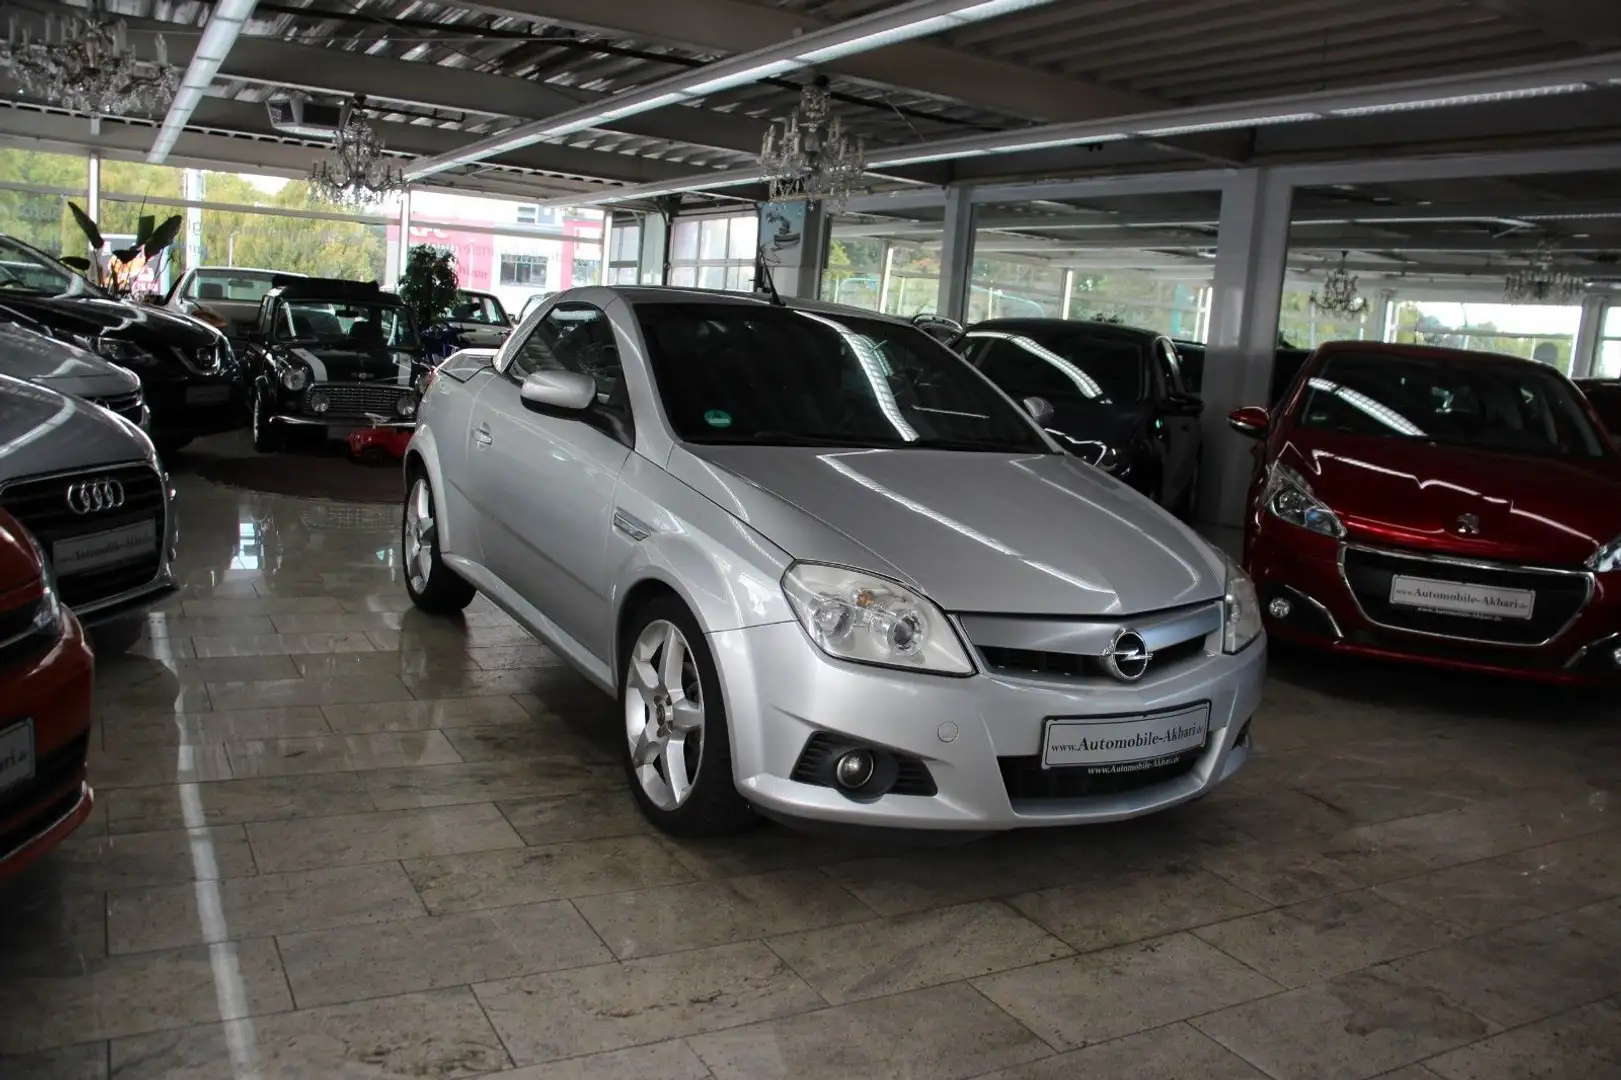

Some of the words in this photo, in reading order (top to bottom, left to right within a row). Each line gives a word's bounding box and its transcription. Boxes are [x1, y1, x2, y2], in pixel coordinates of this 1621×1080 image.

[1396, 588, 1528, 609] www.Automobile-Akbari.de
[1051, 722, 1204, 752] www.Automobile-Akbari.de
[1087, 755, 1180, 775] www.Automobile-Akbari.de
